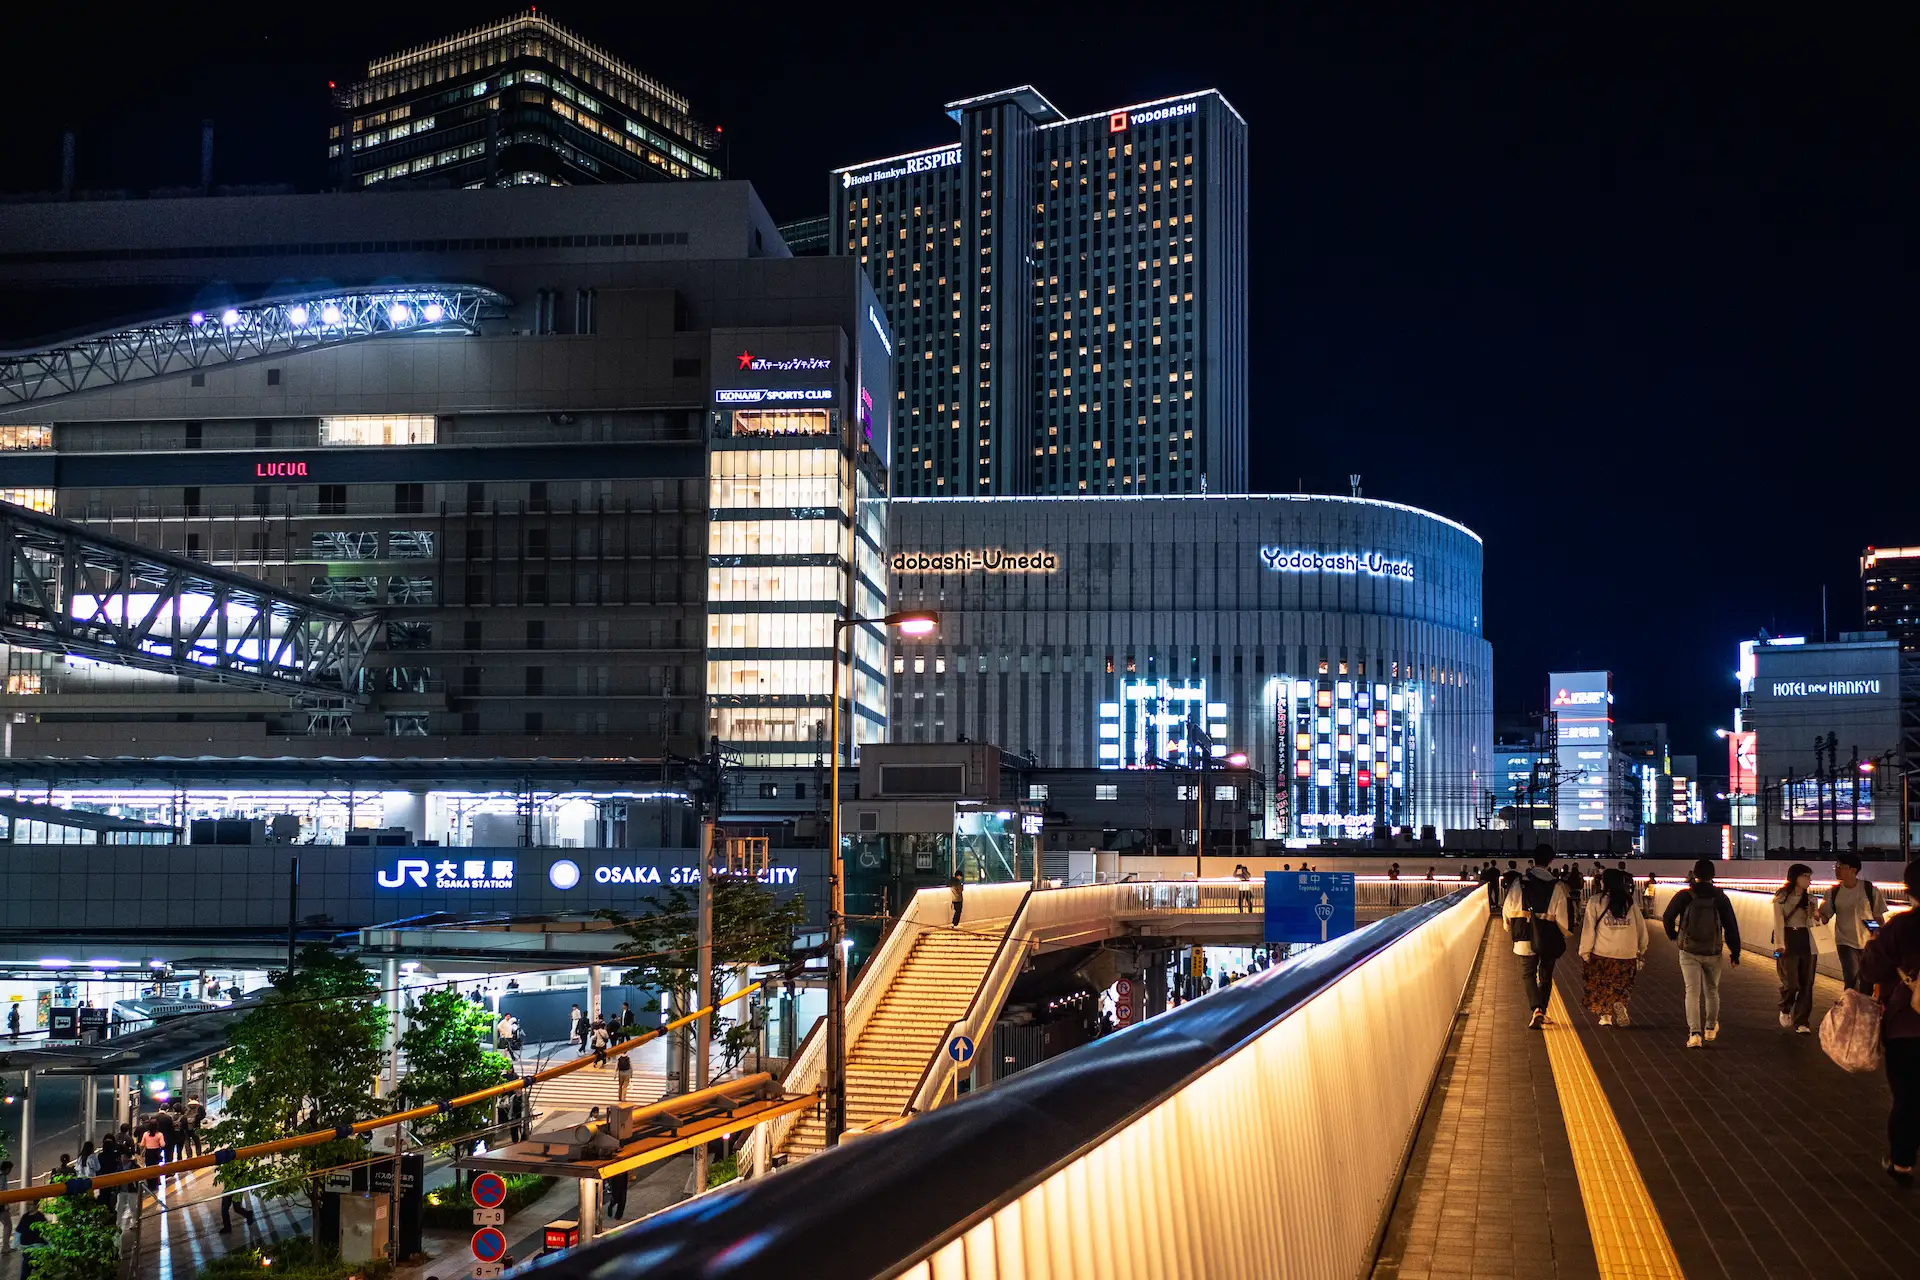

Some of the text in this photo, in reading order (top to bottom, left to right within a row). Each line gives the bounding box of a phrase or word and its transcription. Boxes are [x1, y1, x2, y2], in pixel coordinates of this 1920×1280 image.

[1131, 103, 1196, 125] YODOBASHI
[851, 173, 872, 186] Hotel
[874, 167, 906, 181] Hankyu
[720, 390, 832, 401] KONAMI SPORTS CLUB
[890, 550, 1055, 570] dobashi-Umeda
[1773, 680, 1879, 696] HOTEL new HANKYU
[377, 859, 514, 888] JR 大阪駅
[594, 866, 662, 884] OSAKA
[1328, 874, 1351, 885] 十三
[471, 879, 512, 889] STATION
[1318, 906, 1331, 915] 176
